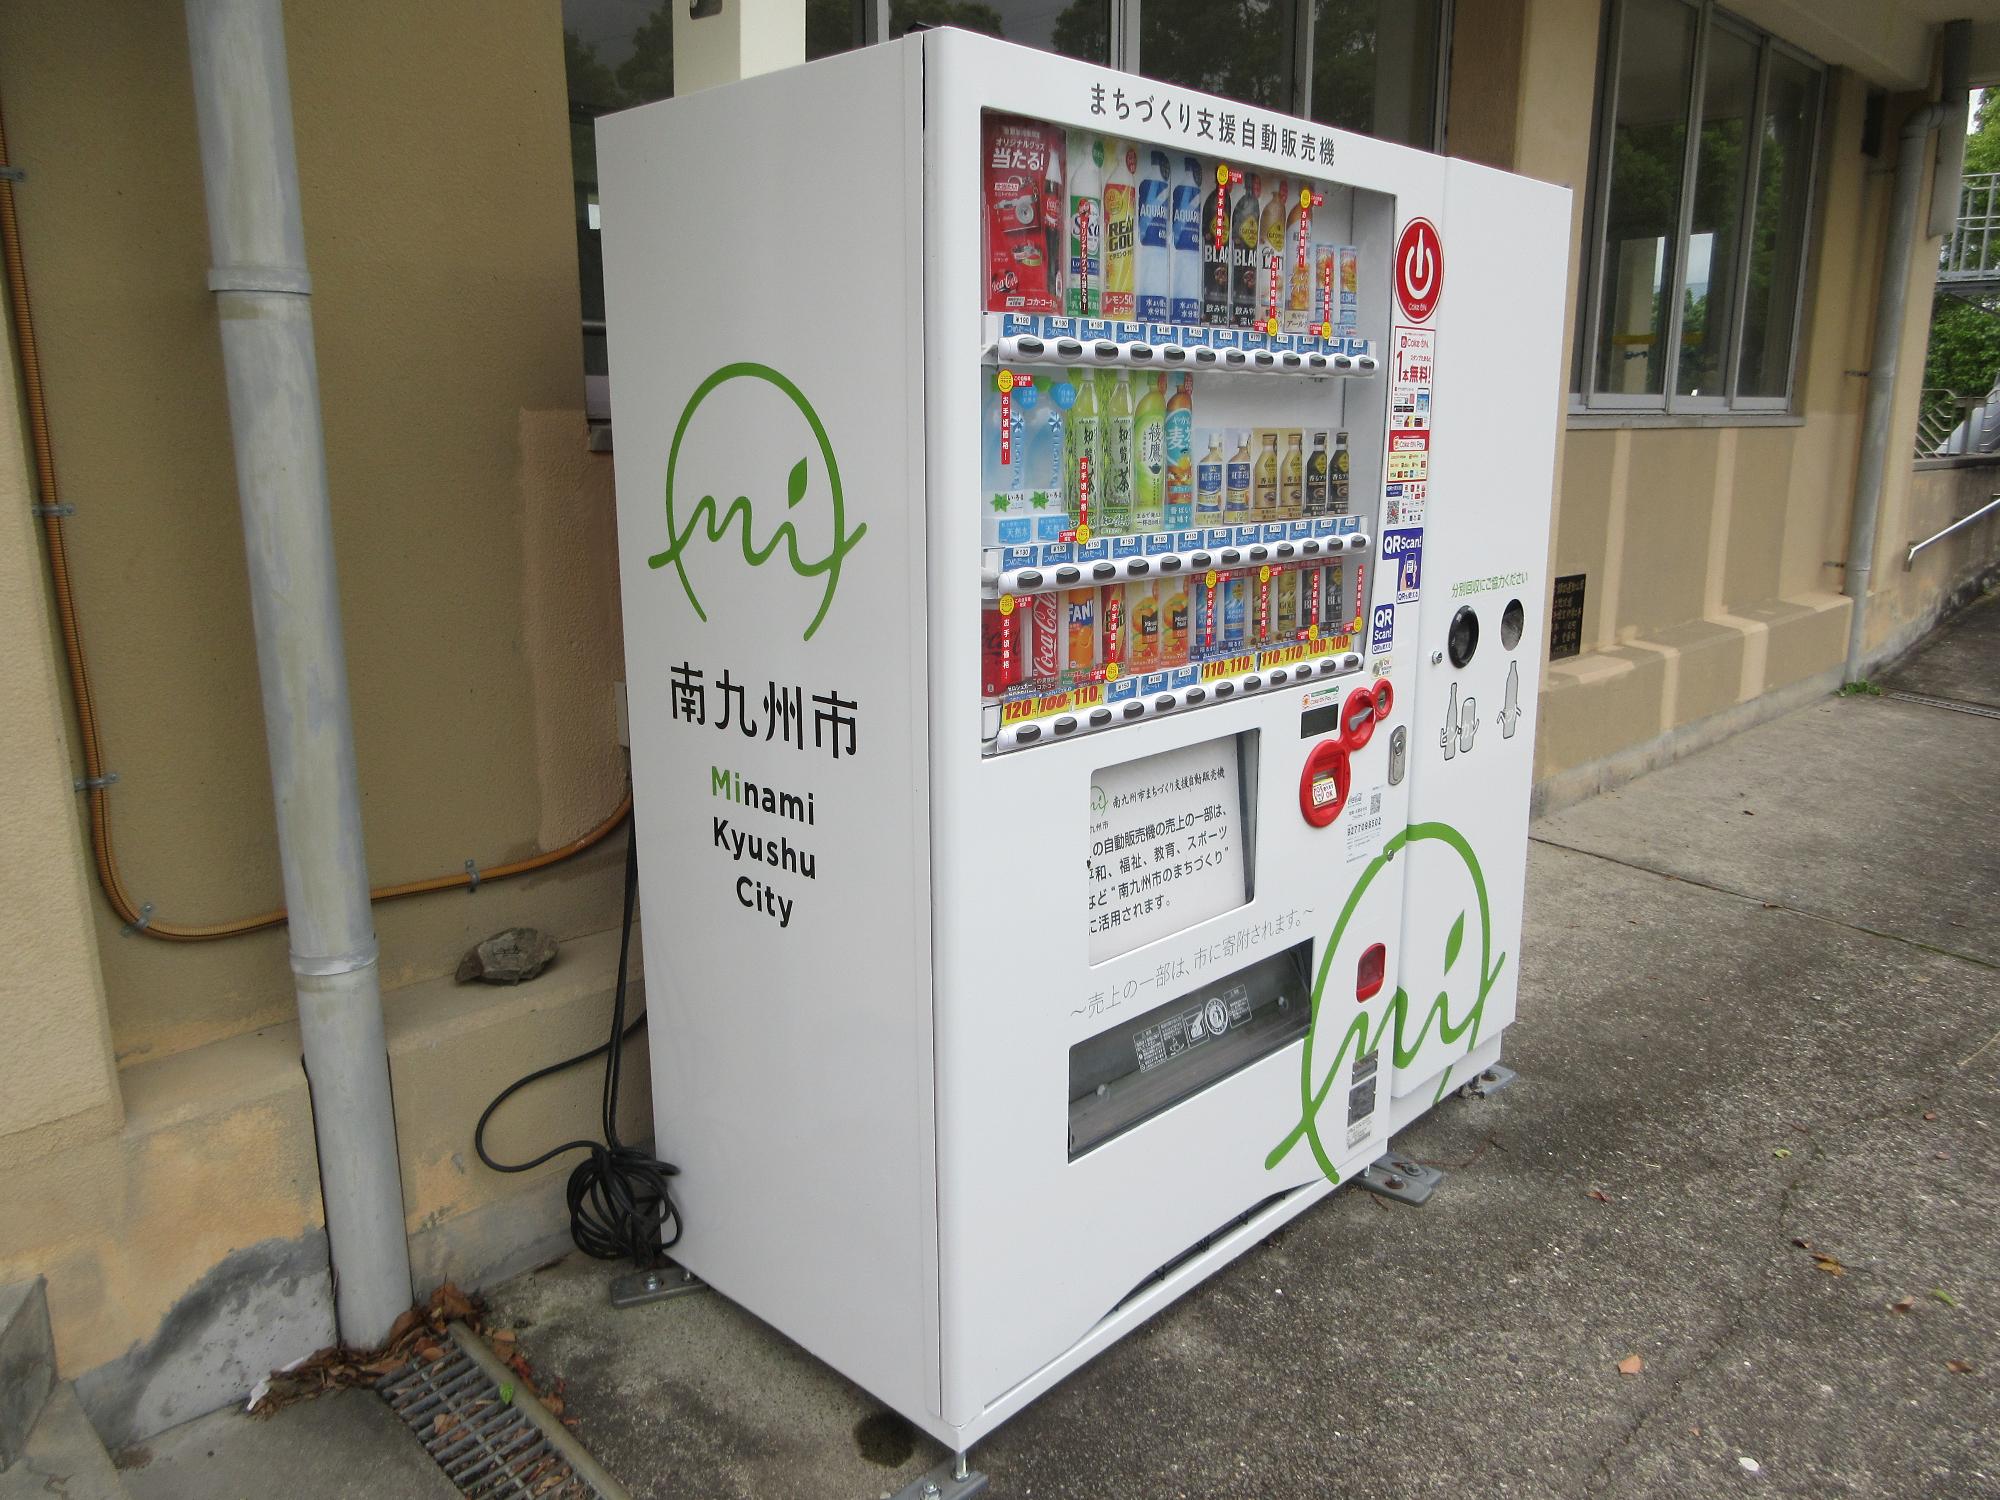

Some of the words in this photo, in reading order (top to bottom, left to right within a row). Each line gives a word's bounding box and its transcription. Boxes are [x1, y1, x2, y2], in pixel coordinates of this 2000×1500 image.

[1090, 82, 1335, 167] まちづくり支援自動販売機
[992, 148, 1044, 171] 当たる!
[1384, 535, 1400, 554] QR
[1401, 536, 1422, 549] Scan!
[1451, 572, 1529, 599] 分別回収にご協力ください
[1374, 628, 1392, 640] Scan!
[1375, 608, 1392, 628] QR
[670, 661, 858, 759] 南九州市
[711, 765, 814, 825] Minami
[1112, 766, 1226, 809] 南九州市まちづくり支援自動販売機
[713, 816, 816, 879] Kyushu
[1090, 804, 1228, 858] の自動販売機の売上の一部は、
[735, 876, 794, 928] City
